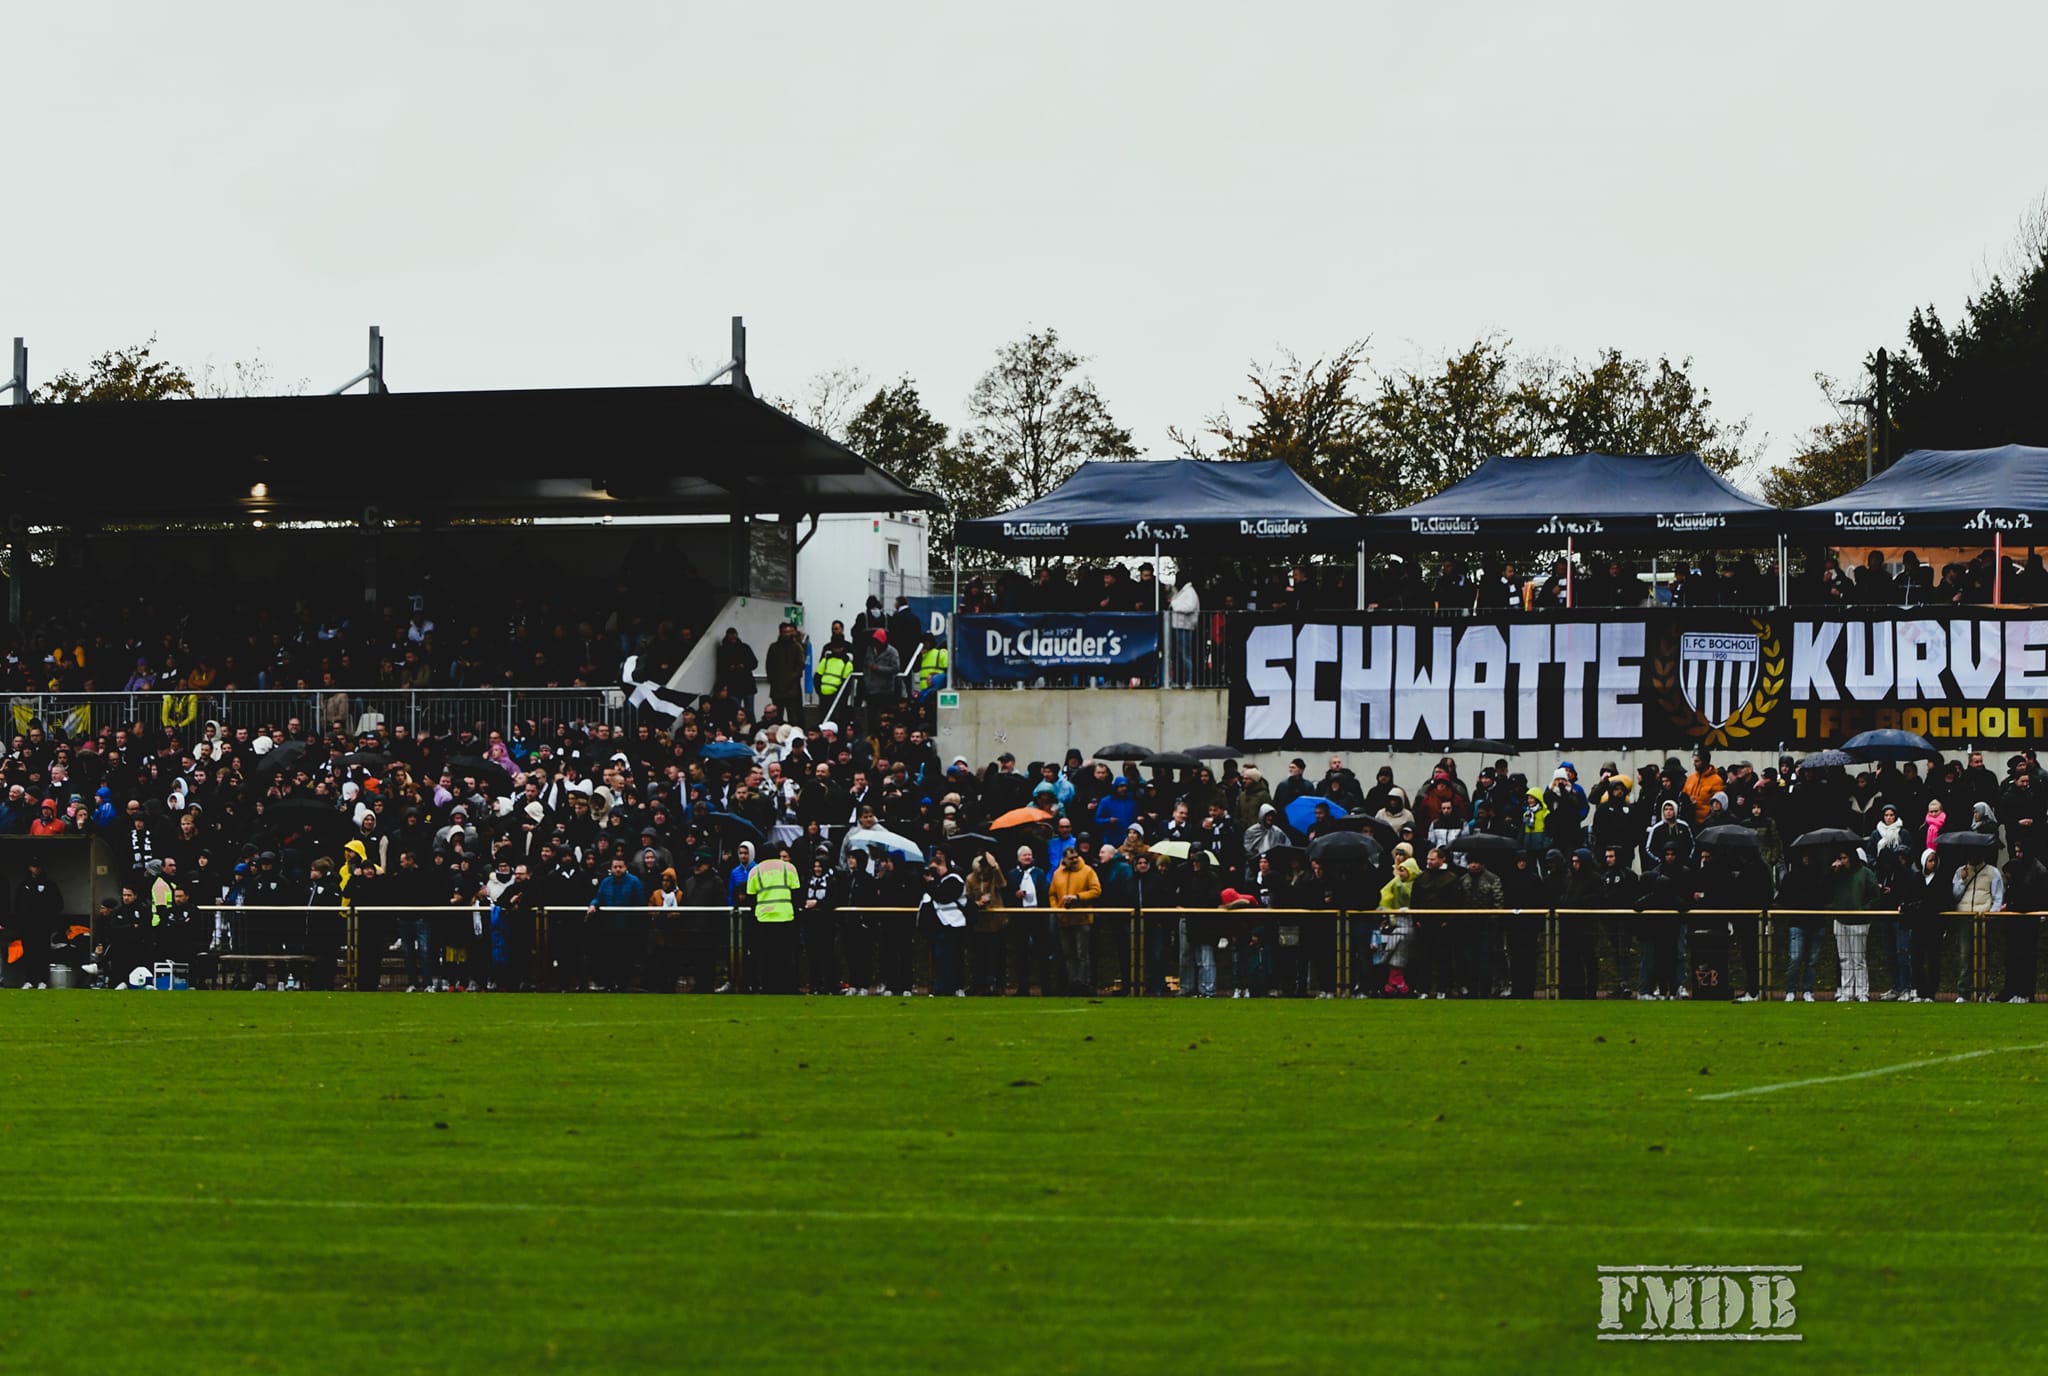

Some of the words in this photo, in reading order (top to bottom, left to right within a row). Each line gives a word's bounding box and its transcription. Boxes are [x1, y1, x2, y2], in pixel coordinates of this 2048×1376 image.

[1693, 638, 1706, 649] FC
[1709, 640, 1755, 650] BOCHOLT
[1790, 619, 2048, 700] KURVE
[1244, 622, 1646, 740] SCHWATTE
[1792, 708, 1807, 738] 1
[1875, 706, 2048, 738] BOCHOLT
